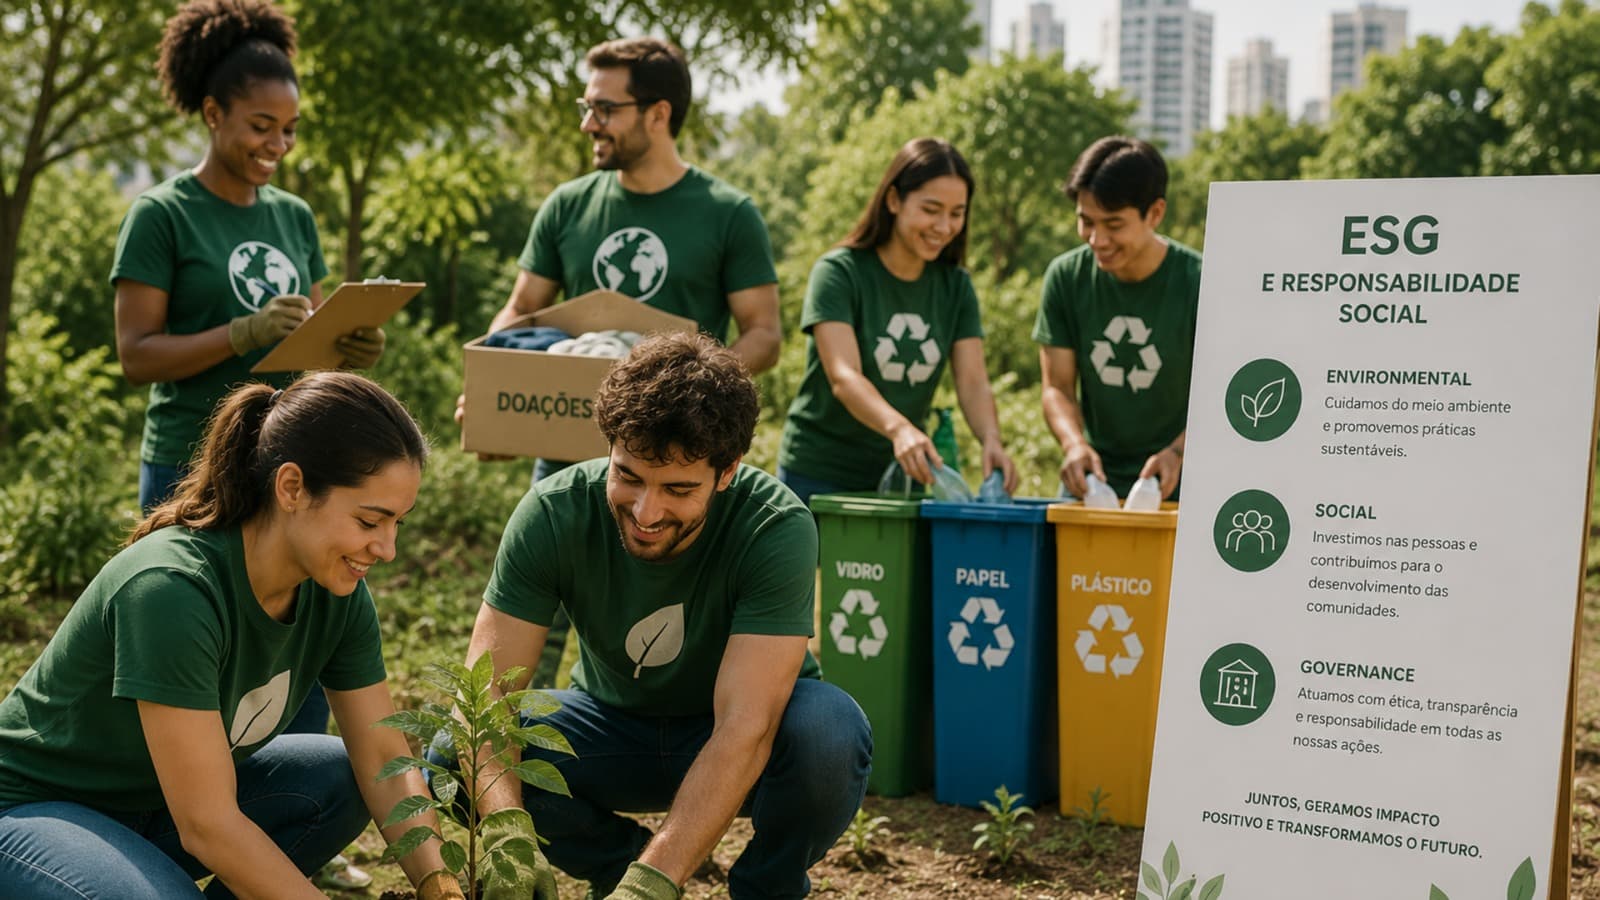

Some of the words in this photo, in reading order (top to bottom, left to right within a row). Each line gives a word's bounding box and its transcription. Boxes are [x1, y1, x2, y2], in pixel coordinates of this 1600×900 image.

[1342, 215, 1438, 255] ESG
[1261, 273, 1274, 291] E
[1282, 273, 1520, 292] RESPONSABILIDADE
[1339, 304, 1427, 323] SOCIAL
[1327, 370, 1471, 386] ENVIRONMENTAL
[498, 392, 593, 420] DOAÇÕES
[1325, 396, 1388, 409] Cuidamos
[1391, 397, 1408, 410] do
[1412, 399, 1444, 411] meio
[1448, 400, 1511, 413] ambiente
[1322, 422, 1330, 431] e
[1334, 422, 1418, 434] promovemos
[1422, 423, 1475, 437] práticas
[1321, 444, 1406, 457] sustentáveis.
[1316, 504, 1376, 519] SOCIAL
[1313, 531, 1382, 545] Investimos
[1386, 536, 1408, 547] nas
[1412, 538, 1465, 550] pessoas
[1468, 541, 1477, 550] e
[836, 561, 884, 580] VIDRO
[1401, 561, 1430, 573] para
[1434, 563, 1443, 573] o
[956, 568, 1009, 588] PAPEL
[1072, 572, 1152, 595] PLÁSTICO
[1309, 577, 1421, 595] desenvolvimento
[1425, 584, 1448, 597] das
[1307, 603, 1399, 617] comunidades.
[1301, 660, 1414, 682] GOVERNANCE
[1298, 688, 1354, 703] Atuamos
[1358, 694, 1385, 706] com
[1389, 695, 1423, 711] ética,
[1428, 699, 1517, 717] transparência
[1295, 712, 1303, 722] e
[1307, 714, 1417, 733] responsabilidade
[1420, 724, 1441, 735] em
[1446, 726, 1483, 739] todas
[1486, 730, 1501, 741] as
[1293, 736, 1337, 749] nossas
[1245, 792, 1300, 811] JUNTOS,
[1305, 800, 1372, 818] GERAMOS
[1377, 808, 1439, 827] IMPACTO
[1203, 811, 1262, 828] POSITIVO
[1266, 818, 1274, 830] E
[1278, 820, 1403, 847] TRANSFORMAMOS
[1406, 836, 1417, 849] O
[1421, 839, 1482, 858] FUTURO.
